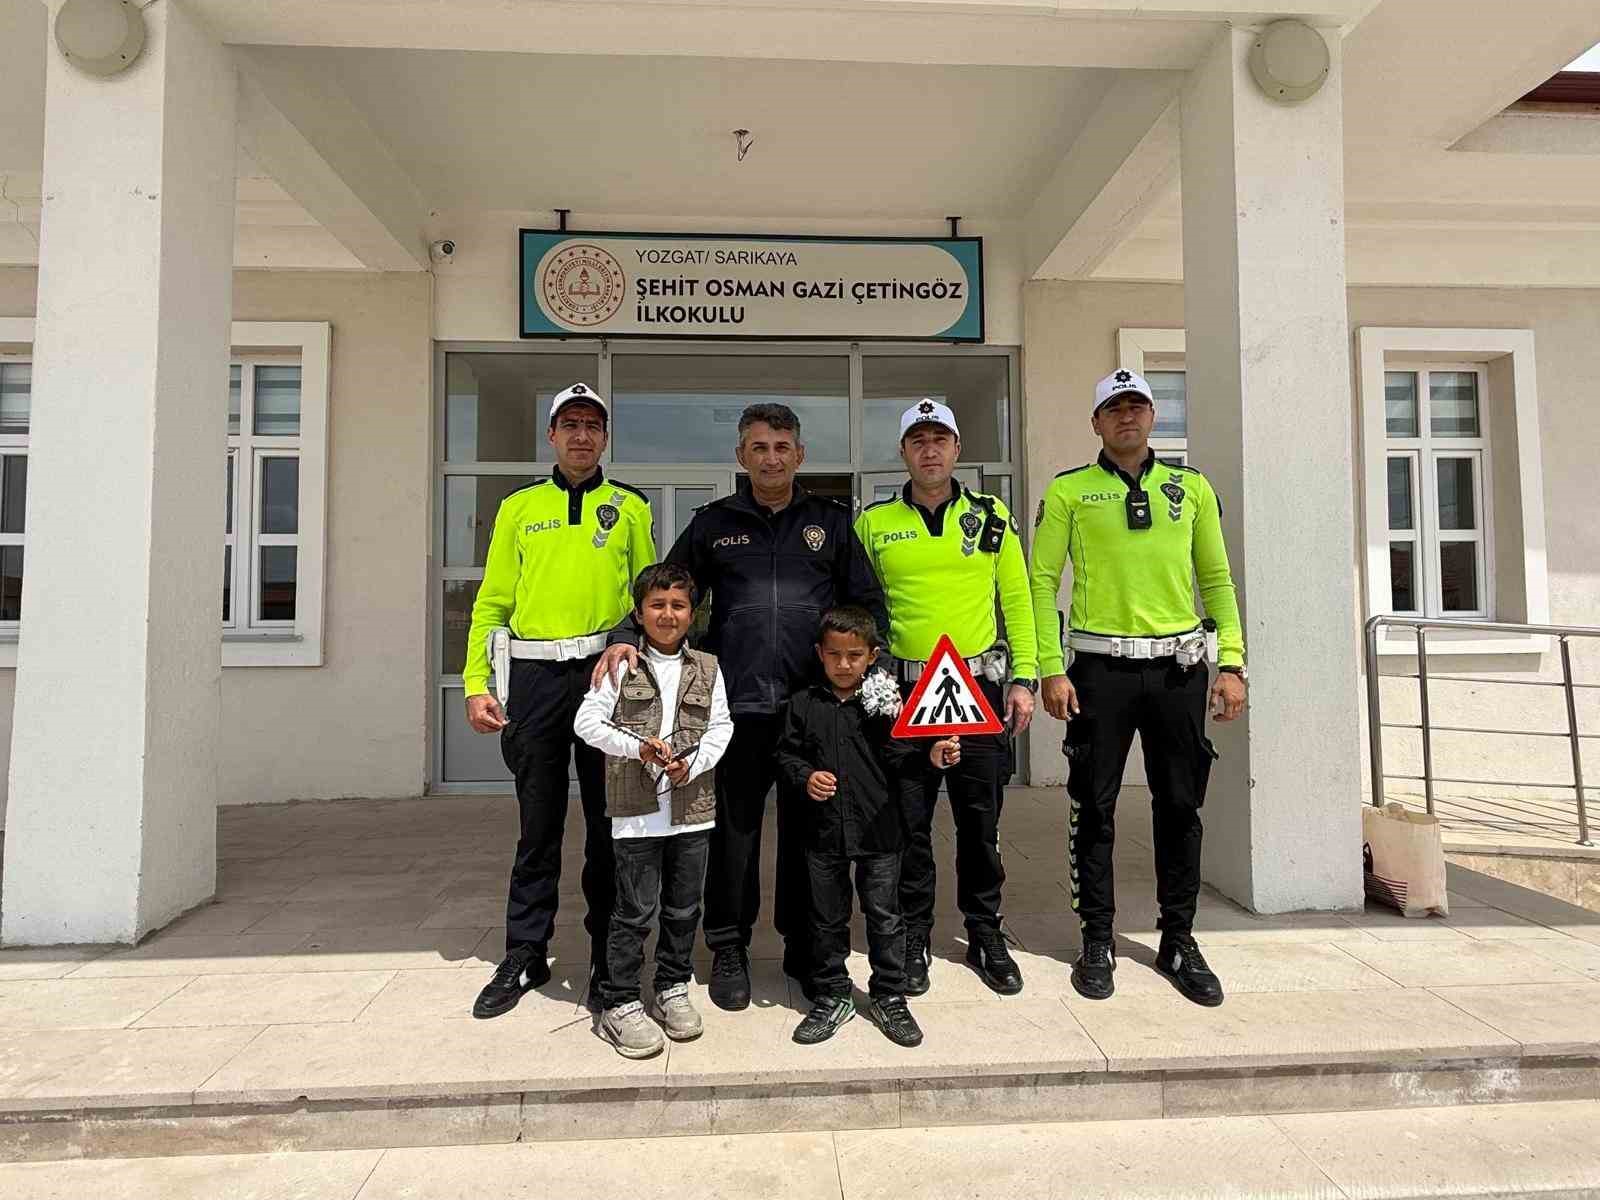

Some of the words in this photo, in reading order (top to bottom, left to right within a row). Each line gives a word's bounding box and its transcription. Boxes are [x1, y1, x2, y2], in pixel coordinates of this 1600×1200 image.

[636, 249, 710, 265] YOZGAT/
[714, 250, 798, 266] SARIKAYA
[636, 274, 699, 301] ŞEHİT
[705, 279, 785, 298] OSMAN
[792, 278, 844, 299] GAZİ
[851, 278, 963, 305] ÇETİNGÖZ
[636, 301, 745, 323] İLKOKULU
